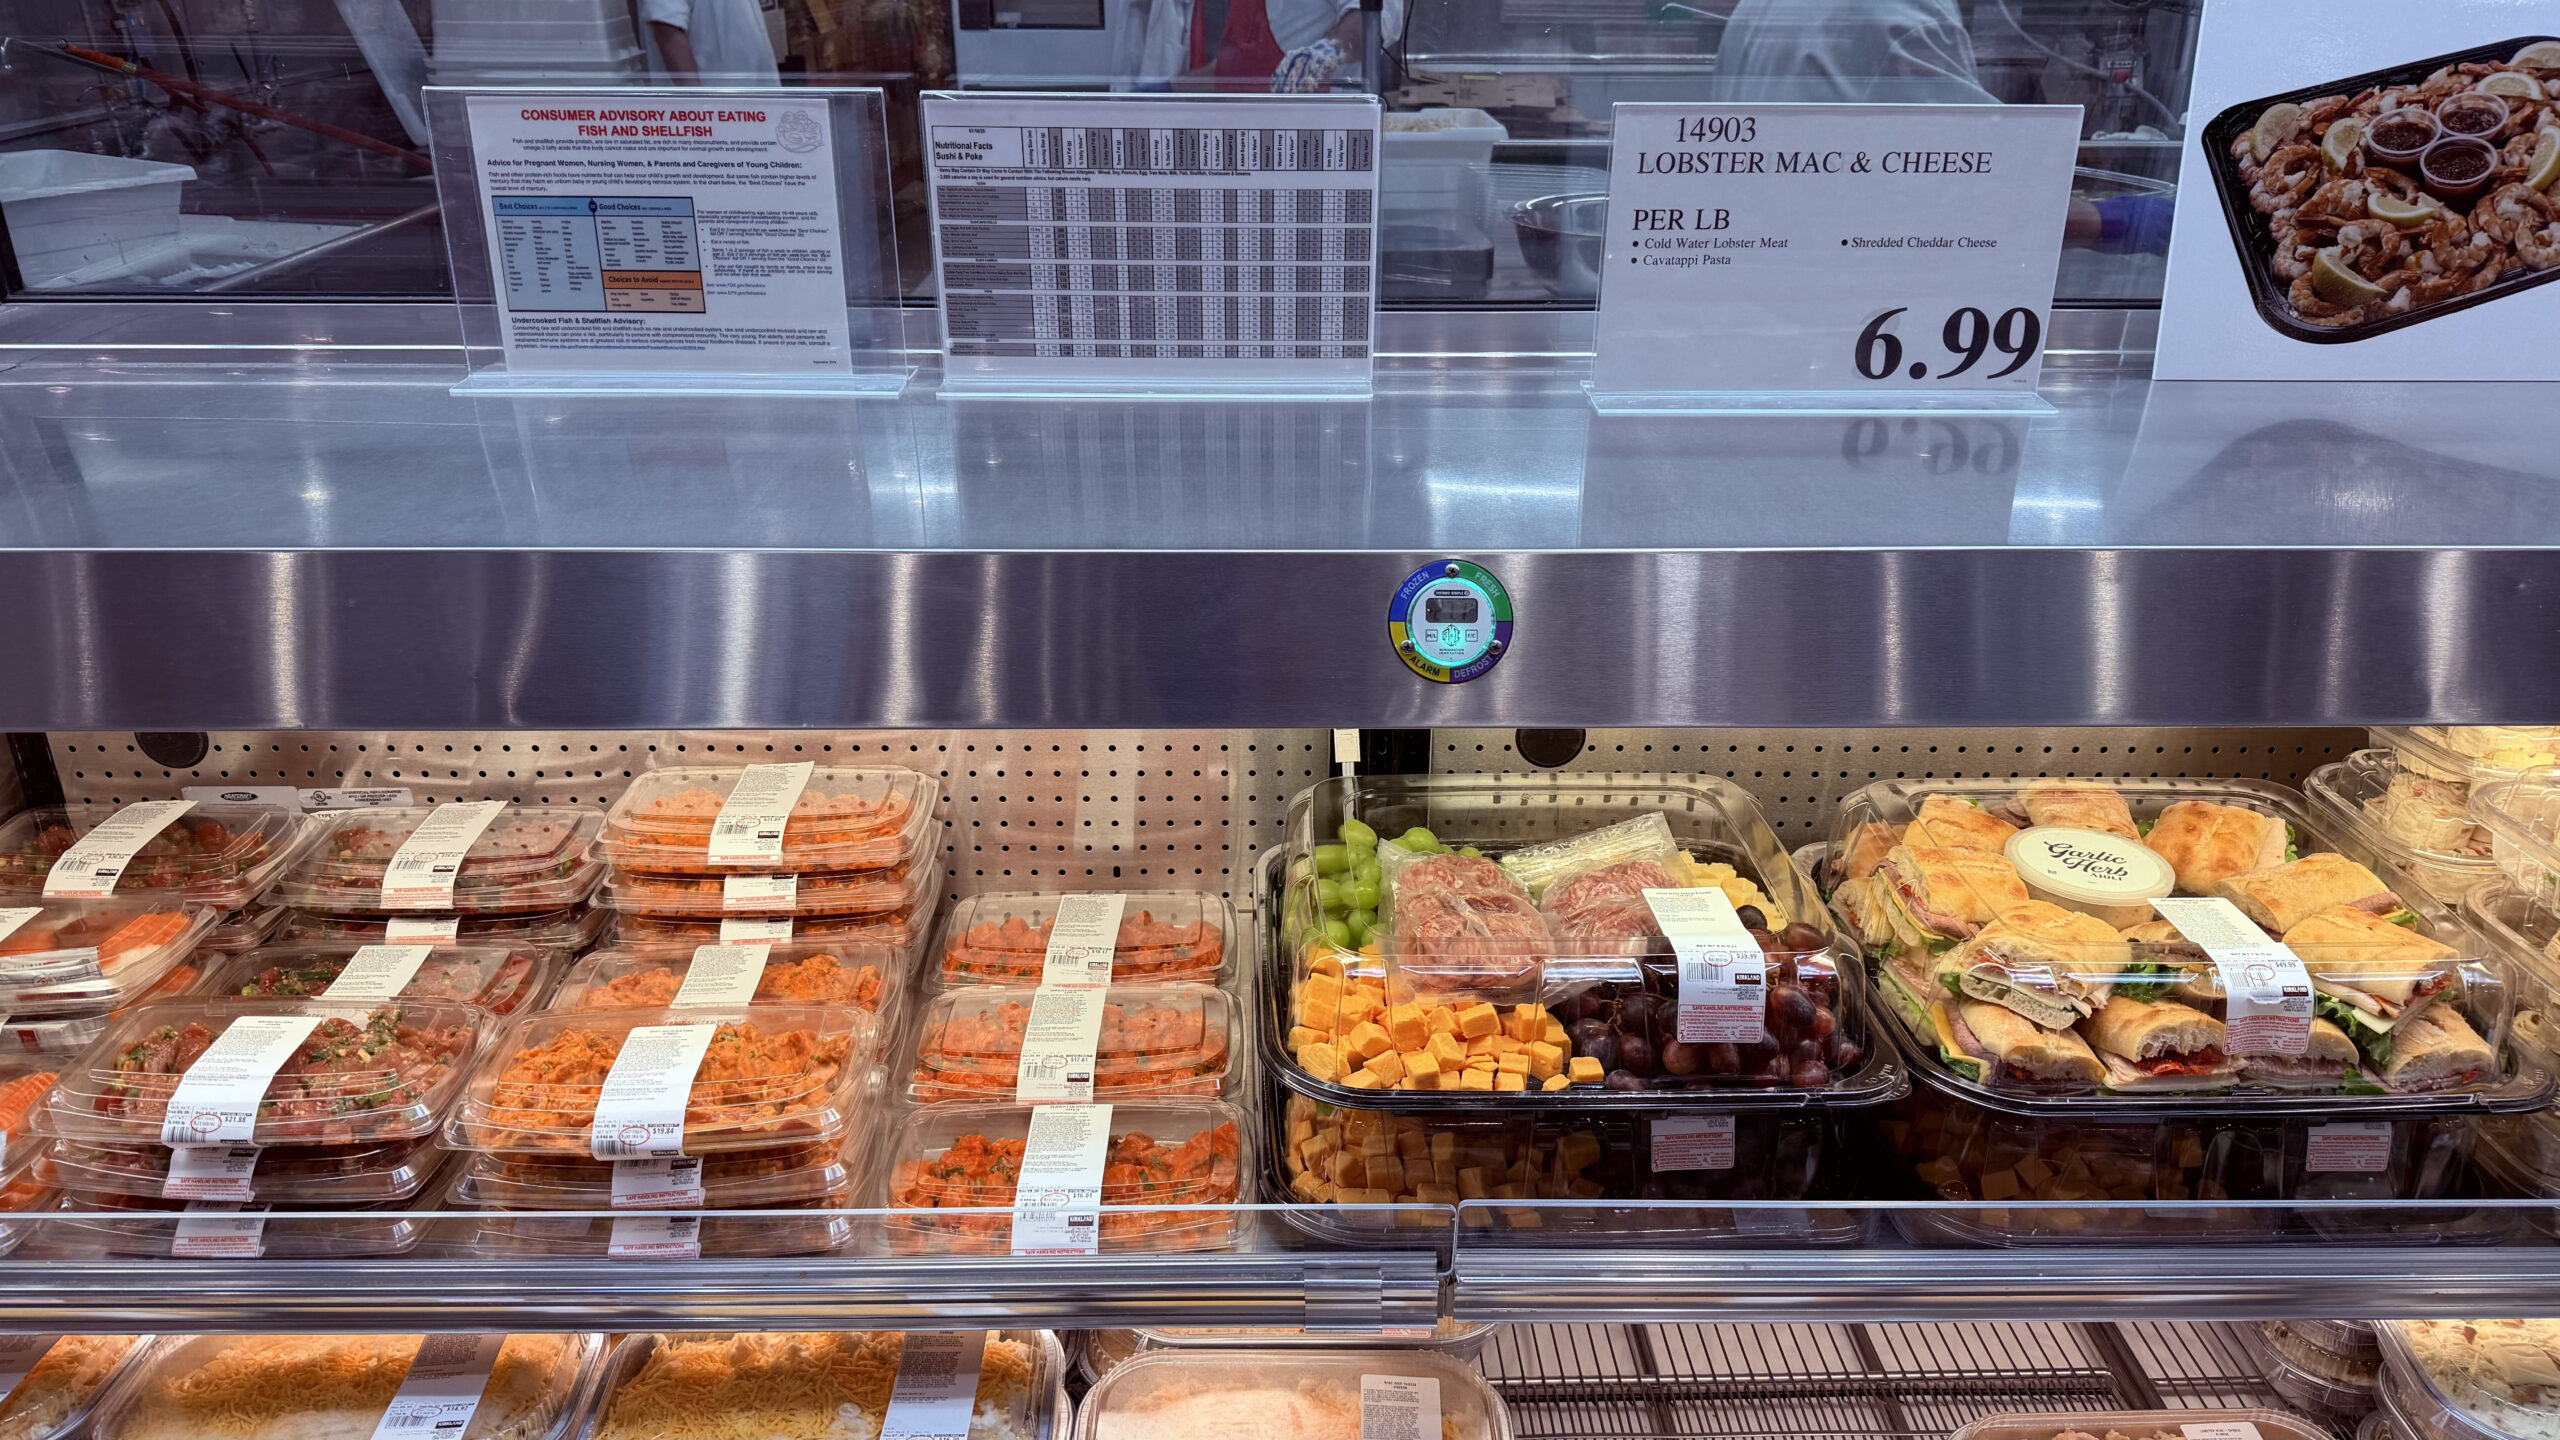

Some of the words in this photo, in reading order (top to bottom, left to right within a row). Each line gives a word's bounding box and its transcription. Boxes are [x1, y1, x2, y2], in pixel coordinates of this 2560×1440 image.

[520, 110, 595, 120] CONSUMER
[599, 110, 664, 121] ADVISORY
[669, 111, 713, 121] ABOUT
[717, 111, 766, 122] EATING
[578, 126, 607, 136] FISH
[611, 126, 638, 137] AND
[641, 126, 712, 137] SHELLFISH
[1675, 117, 1757, 143] 14903
[524, 160, 556, 168] Pregnant
[557, 160, 586, 168] Women,
[587, 160, 616, 169] Nursing
[616, 161, 645, 169] Women,
[696, 162, 735, 170] Caregivers
[745, 162, 768, 170] Young
[1637, 152, 1766, 174] LOBSTER
[1774, 152, 1841, 174] MAC
[1850, 152, 1872, 174] &
[1881, 152, 1994, 174] CHEESE
[1632, 208, 1685, 232] PER
[1694, 208, 1730, 232] LB
[1644, 238, 1672, 249] Cold
[1676, 238, 1709, 249] Water
[1713, 238, 1756, 249] Lobster
[1759, 238, 1788, 249] Meat
[1851, 237, 1904, 248] Shredded
[1907, 237, 1954, 248] Cheddar
[1957, 237, 1997, 248] Cheese
[1642, 254, 1699, 268] Cavatappi
[1702, 254, 1731, 266] Pasta
[612, 318, 645, 327] Advisory:
[1854, 306, 2040, 380] 6.99
[1400, 570, 1430, 600] FROZEN
[1474, 572, 1500, 598] FRESH
[1410, 654, 1440, 677] ALARM
[1454, 654, 1494, 678] DEFROST
[2044, 841, 2126, 864] Garlic
[2062, 857, 2128, 876] Herb
